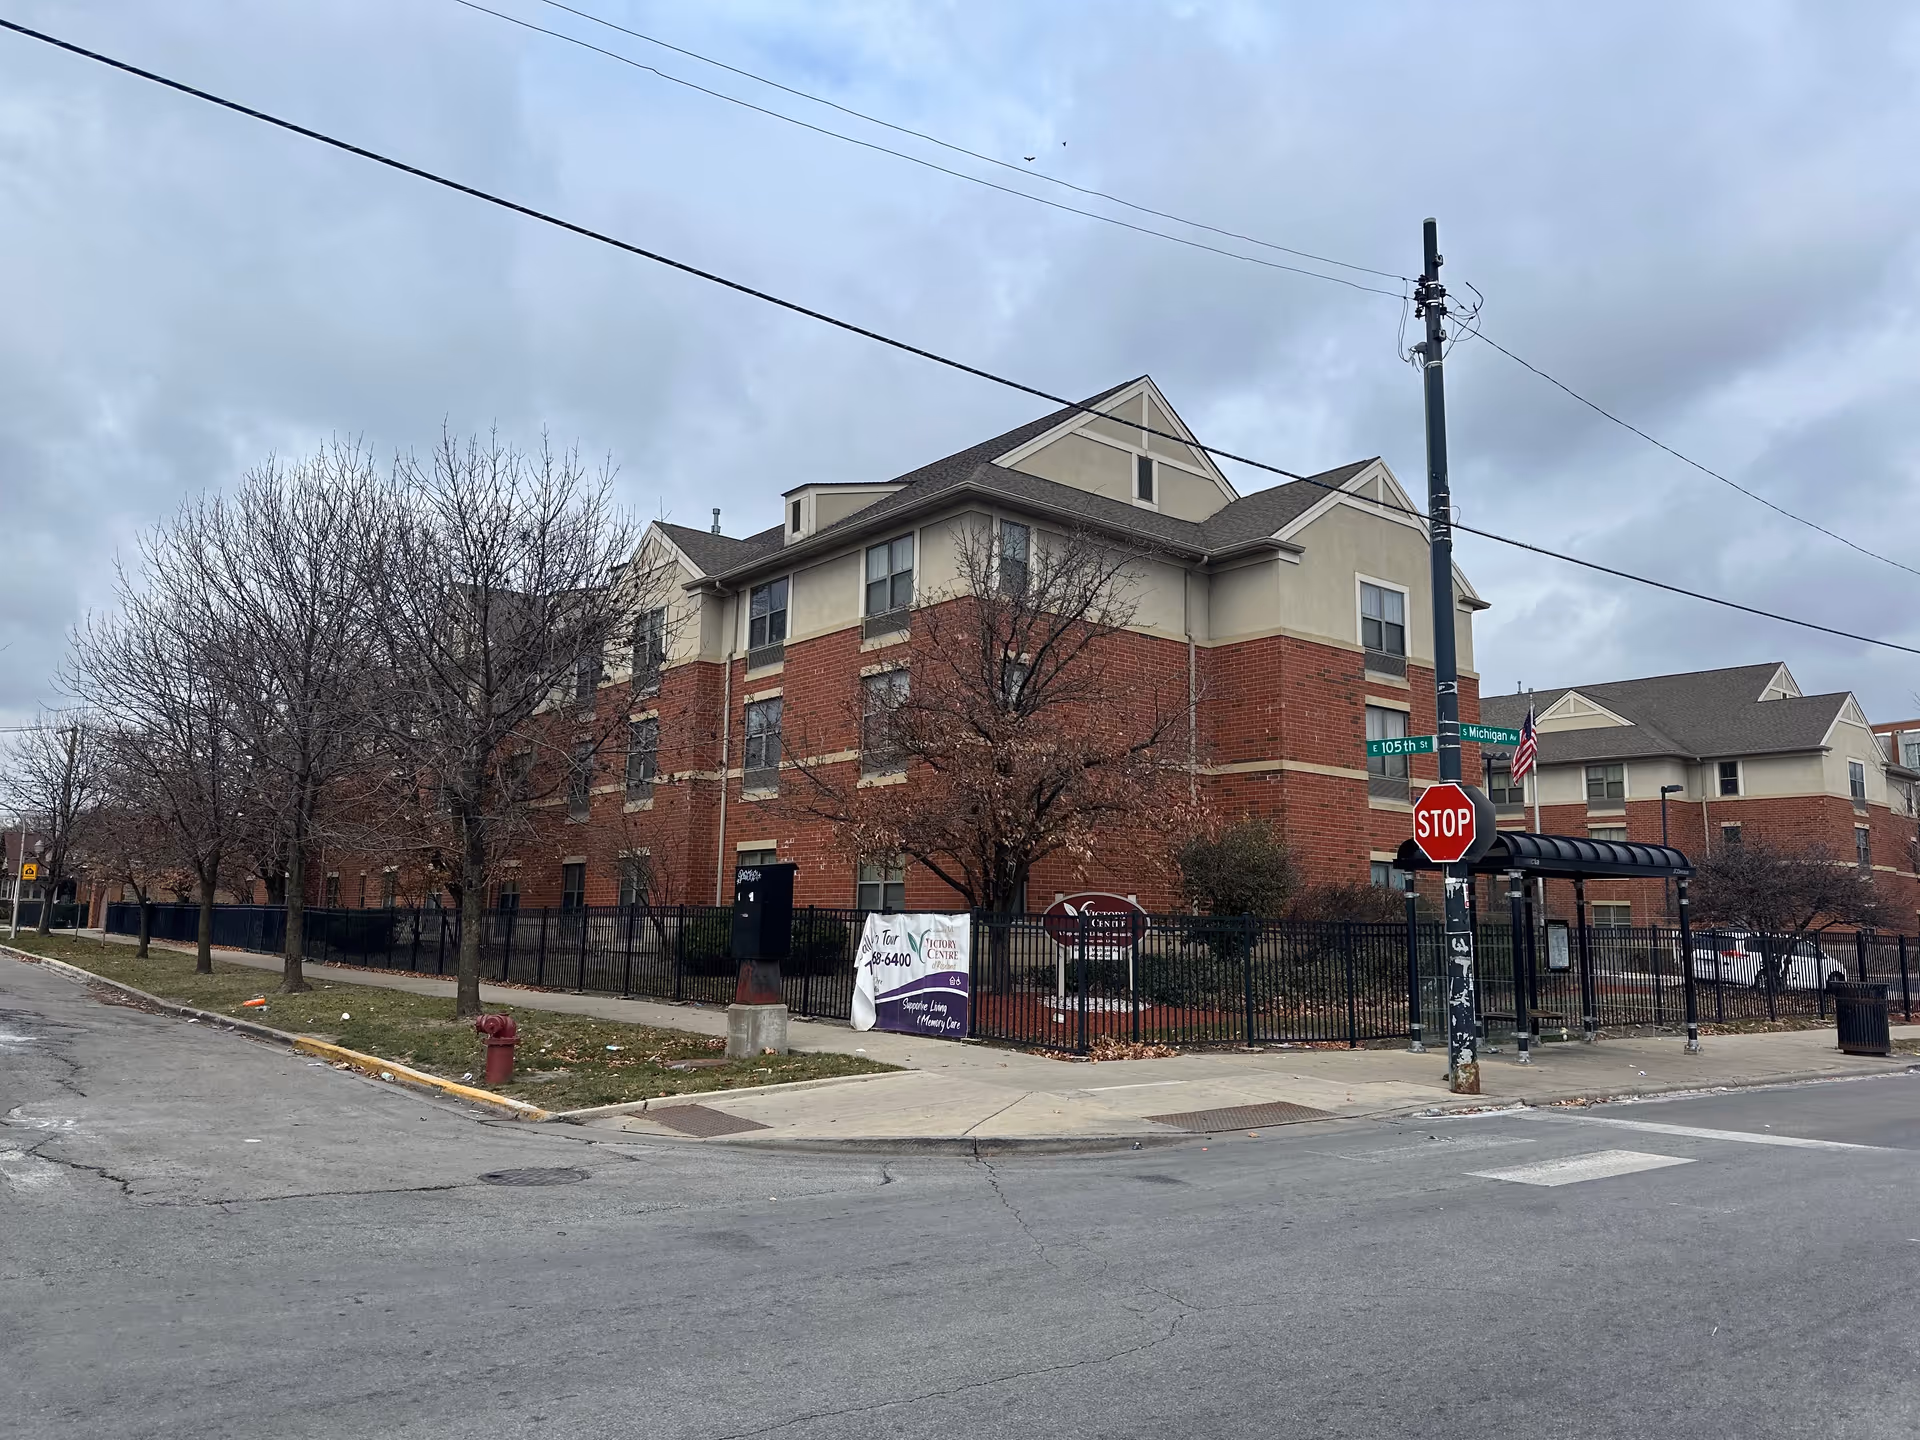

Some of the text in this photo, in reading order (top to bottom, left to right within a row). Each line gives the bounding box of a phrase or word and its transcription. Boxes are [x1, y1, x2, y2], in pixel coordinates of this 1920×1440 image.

[1462, 728, 1467, 736] S
[1469, 726, 1507, 743] Michigan
[1372, 740, 1428, 753] E 105th St
[1418, 808, 1471, 838] STOP
[882, 929, 899, 946] Tour
[926, 937, 956, 949] VICTORY
[927, 949, 959, 960] CENTRE
[930, 999, 947, 1017] Living
[920, 1014, 946, 1033] Memory
[946, 1016, 961, 1030] Care
